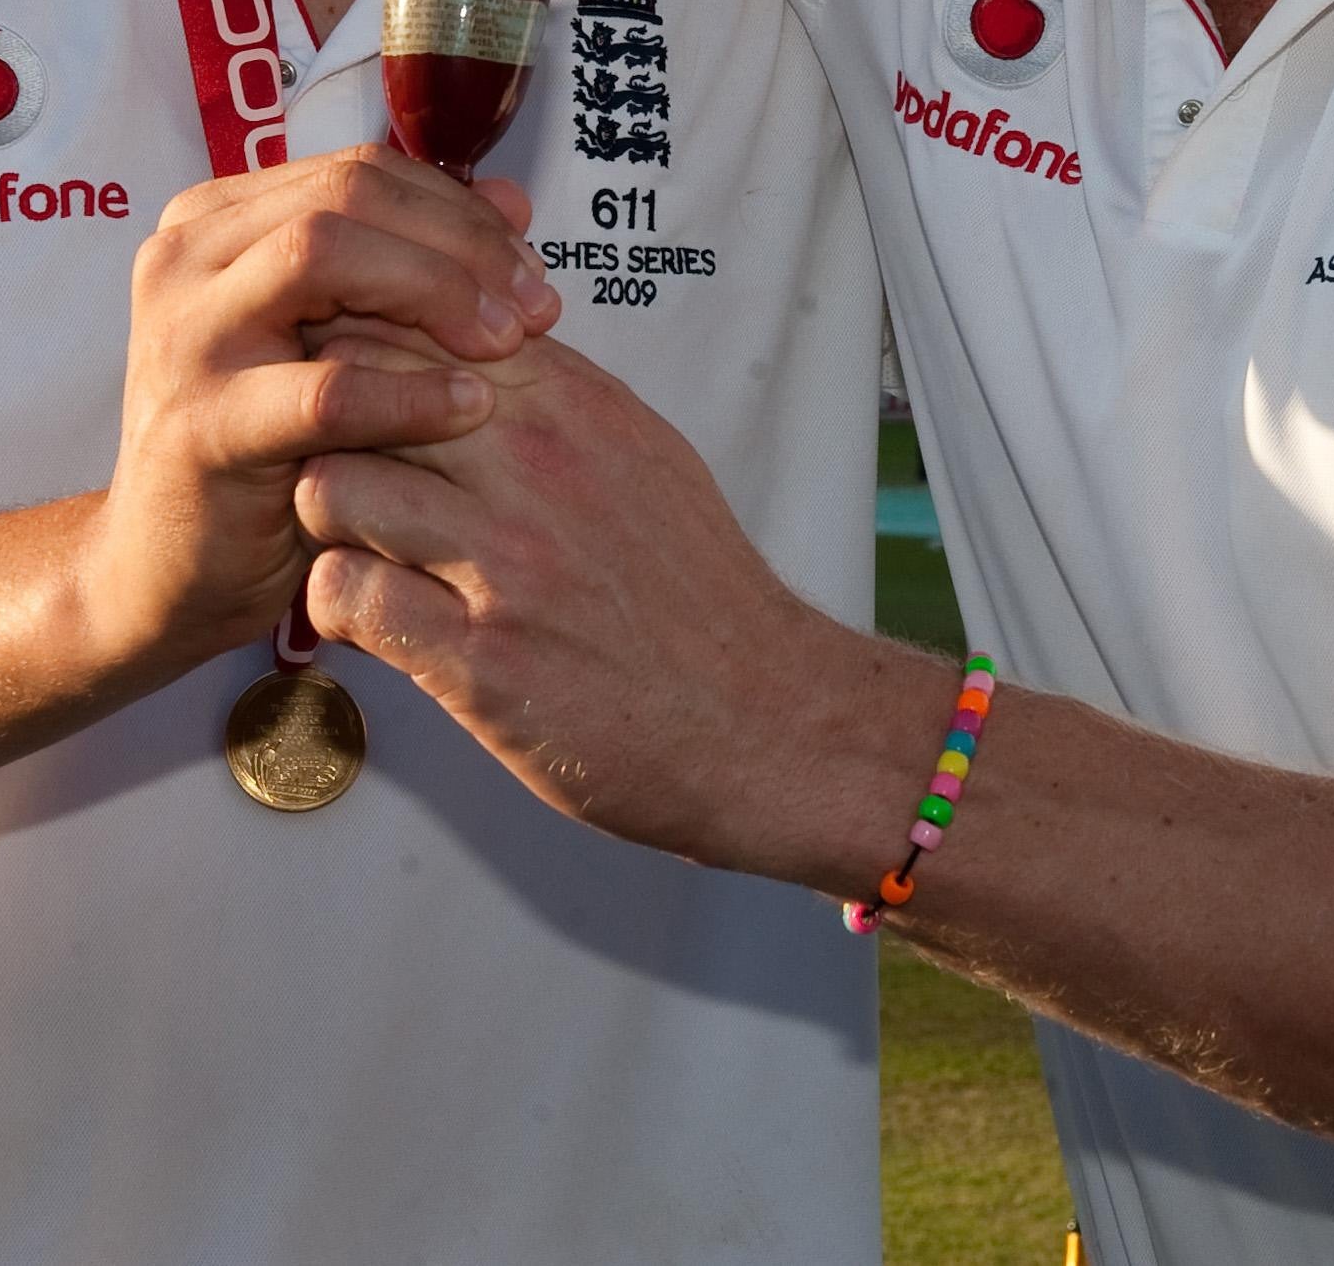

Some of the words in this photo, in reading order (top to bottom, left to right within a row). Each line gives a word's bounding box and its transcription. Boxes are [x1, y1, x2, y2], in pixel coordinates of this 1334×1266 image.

[894, 70, 1082, 184] vodafone
[591, 187, 656, 232] 611
[527, 241, 619, 271] SHES
[627, 246, 716, 276] SERIES
[592, 276, 657, 307] 2009
